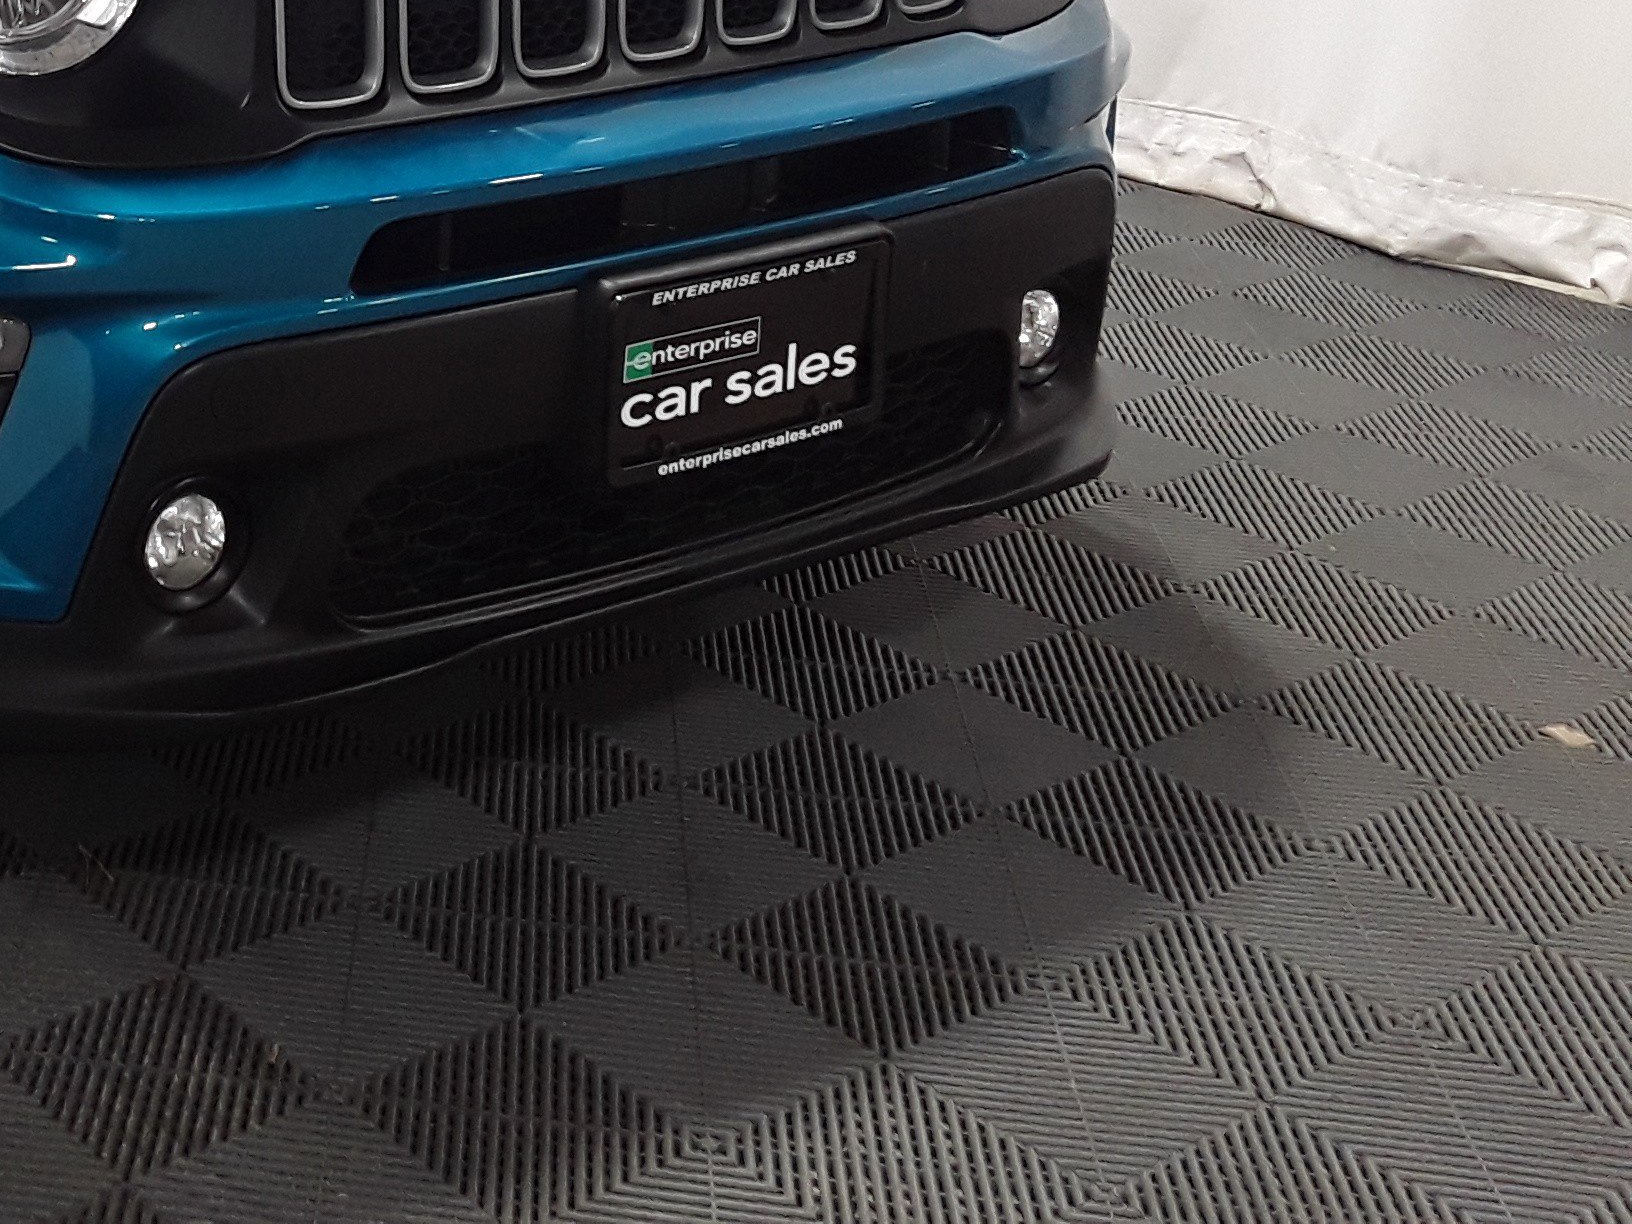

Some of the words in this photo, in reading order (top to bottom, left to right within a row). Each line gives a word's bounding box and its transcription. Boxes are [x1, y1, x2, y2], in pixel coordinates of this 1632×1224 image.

[651, 271, 762, 307] ENTERPRISE
[765, 262, 800, 282] CAR
[804, 250, 857, 271] SALES
[627, 328, 757, 370] enterprise
[620, 377, 713, 428] car
[724, 342, 858, 406] sales
[657, 418, 844, 476] enterprisecarsales.com
